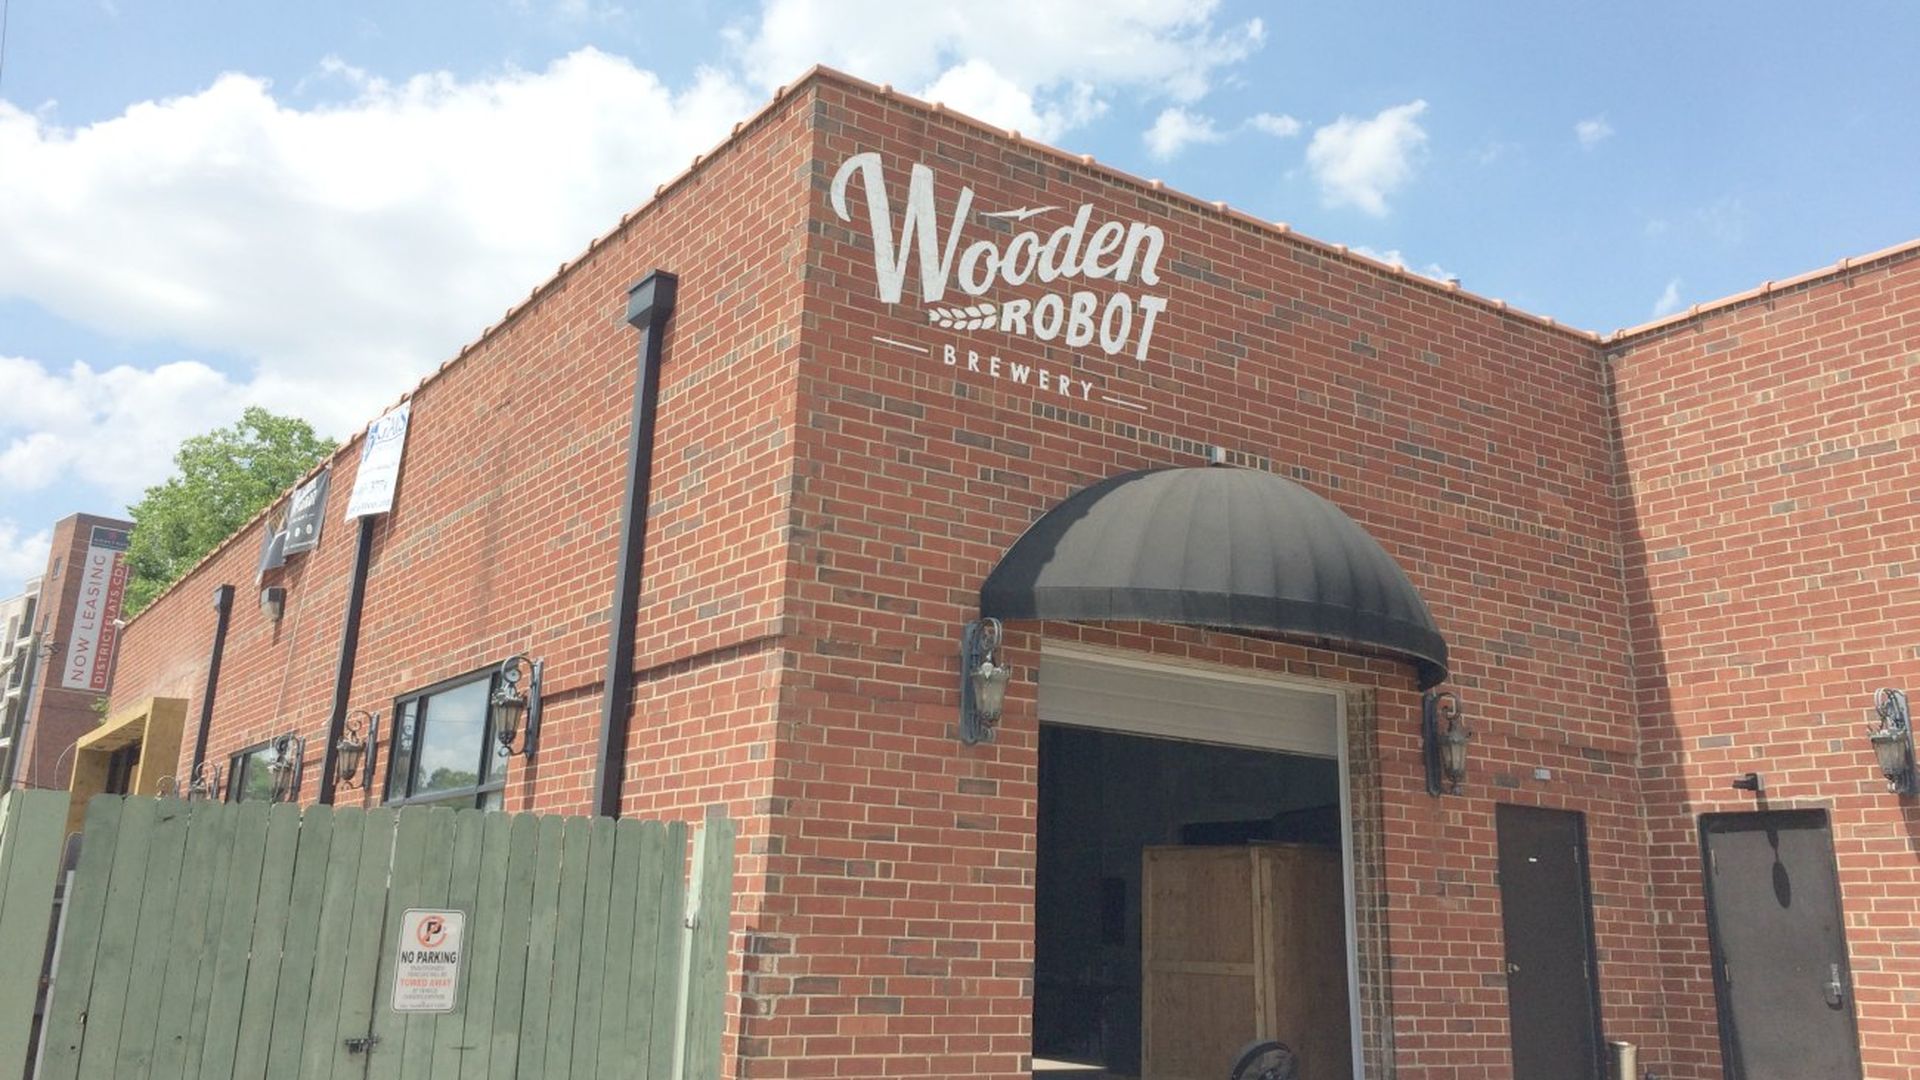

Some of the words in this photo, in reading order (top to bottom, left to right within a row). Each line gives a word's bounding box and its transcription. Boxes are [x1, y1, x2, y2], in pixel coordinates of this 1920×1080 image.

[830, 152, 1165, 303] Wooden
[1000, 291, 1168, 361] ROBOT
[943, 344, 1093, 401] BREWERY
[80, 554, 106, 630] LEASING
[71, 637, 90, 682] NOW
[401, 951, 414, 964] NO
[416, 951, 456, 964] PARKING
